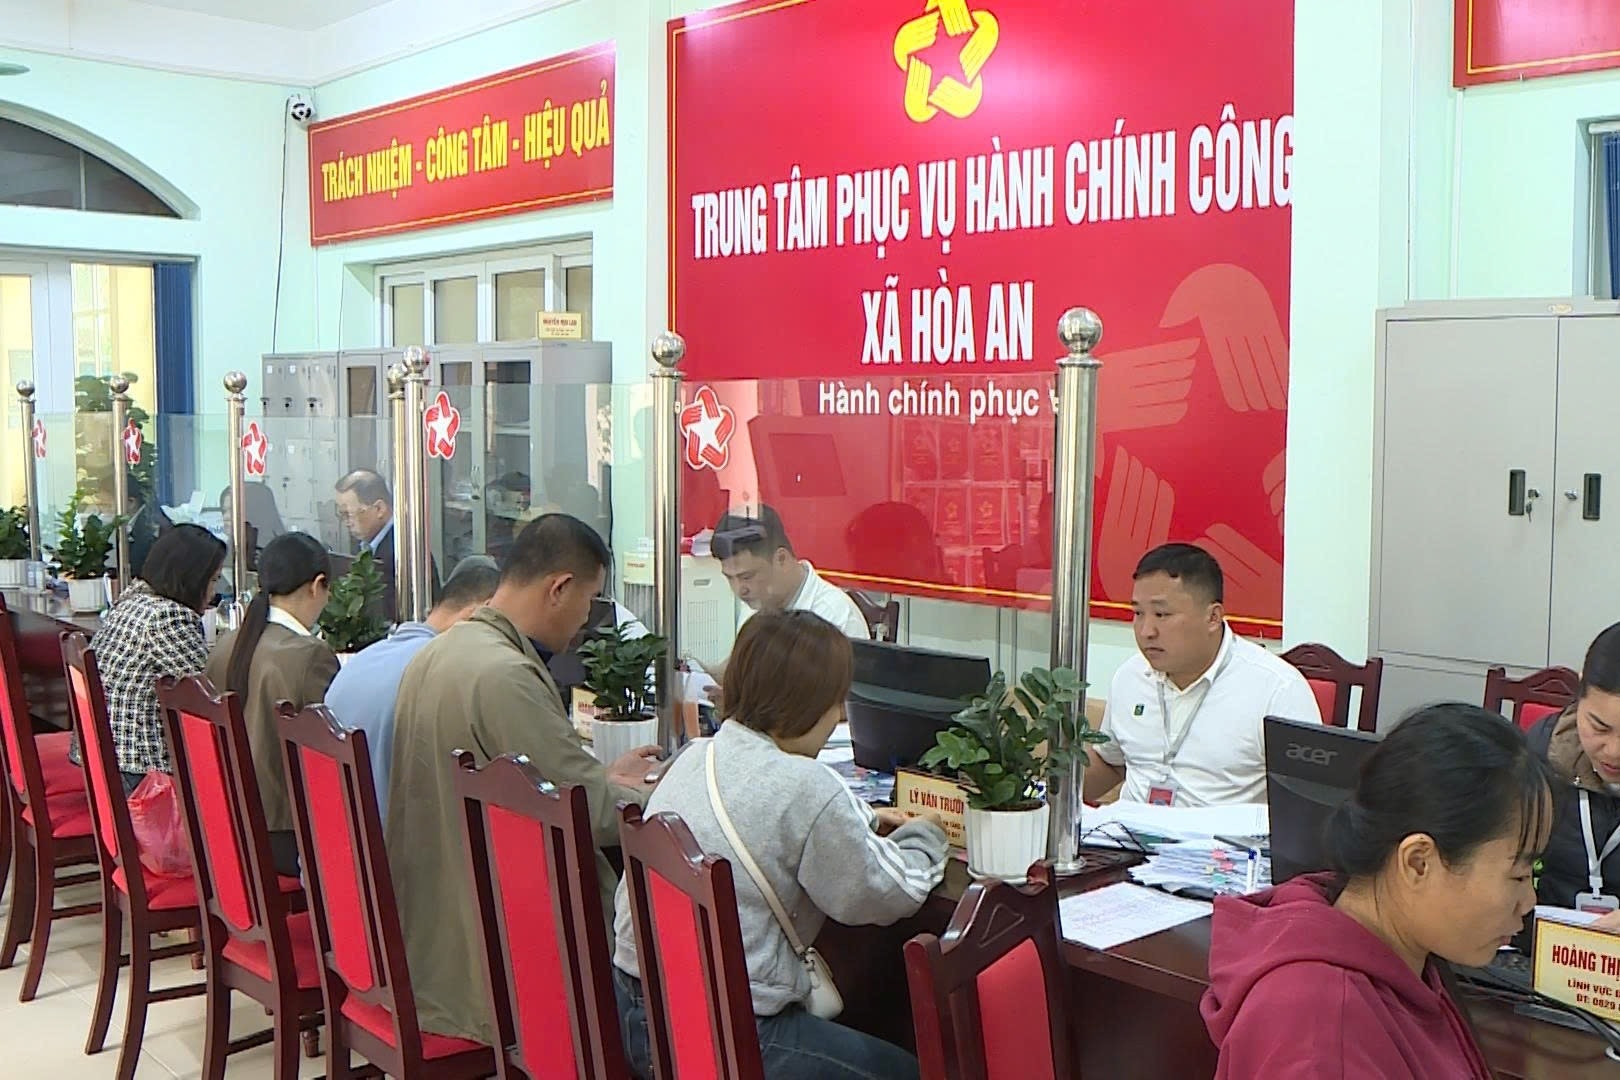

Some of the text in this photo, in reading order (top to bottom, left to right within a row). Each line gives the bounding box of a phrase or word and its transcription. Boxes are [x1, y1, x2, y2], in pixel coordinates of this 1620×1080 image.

[321, 151, 364, 203] TRÁCH
[366, 137, 413, 200] NHIỆM
[425, 125, 469, 183] CÔNG
[471, 114, 509, 173] TÂM
[523, 97, 567, 169] HIỆU
[570, 80, 611, 158] QUẢ
[691, 101, 1294, 260] TRUNG TÂM PHỤC VỤ HÀNH CHÍNH CÔNG
[860, 266, 1035, 365] XÃ HÒA AN
[818, 380, 881, 416] Hành
[887, 379, 961, 417] chính
[969, 379, 1041, 425] phục
[1285, 743, 1339, 766] acer
[1552, 944, 1596, 971] HOÀNG
